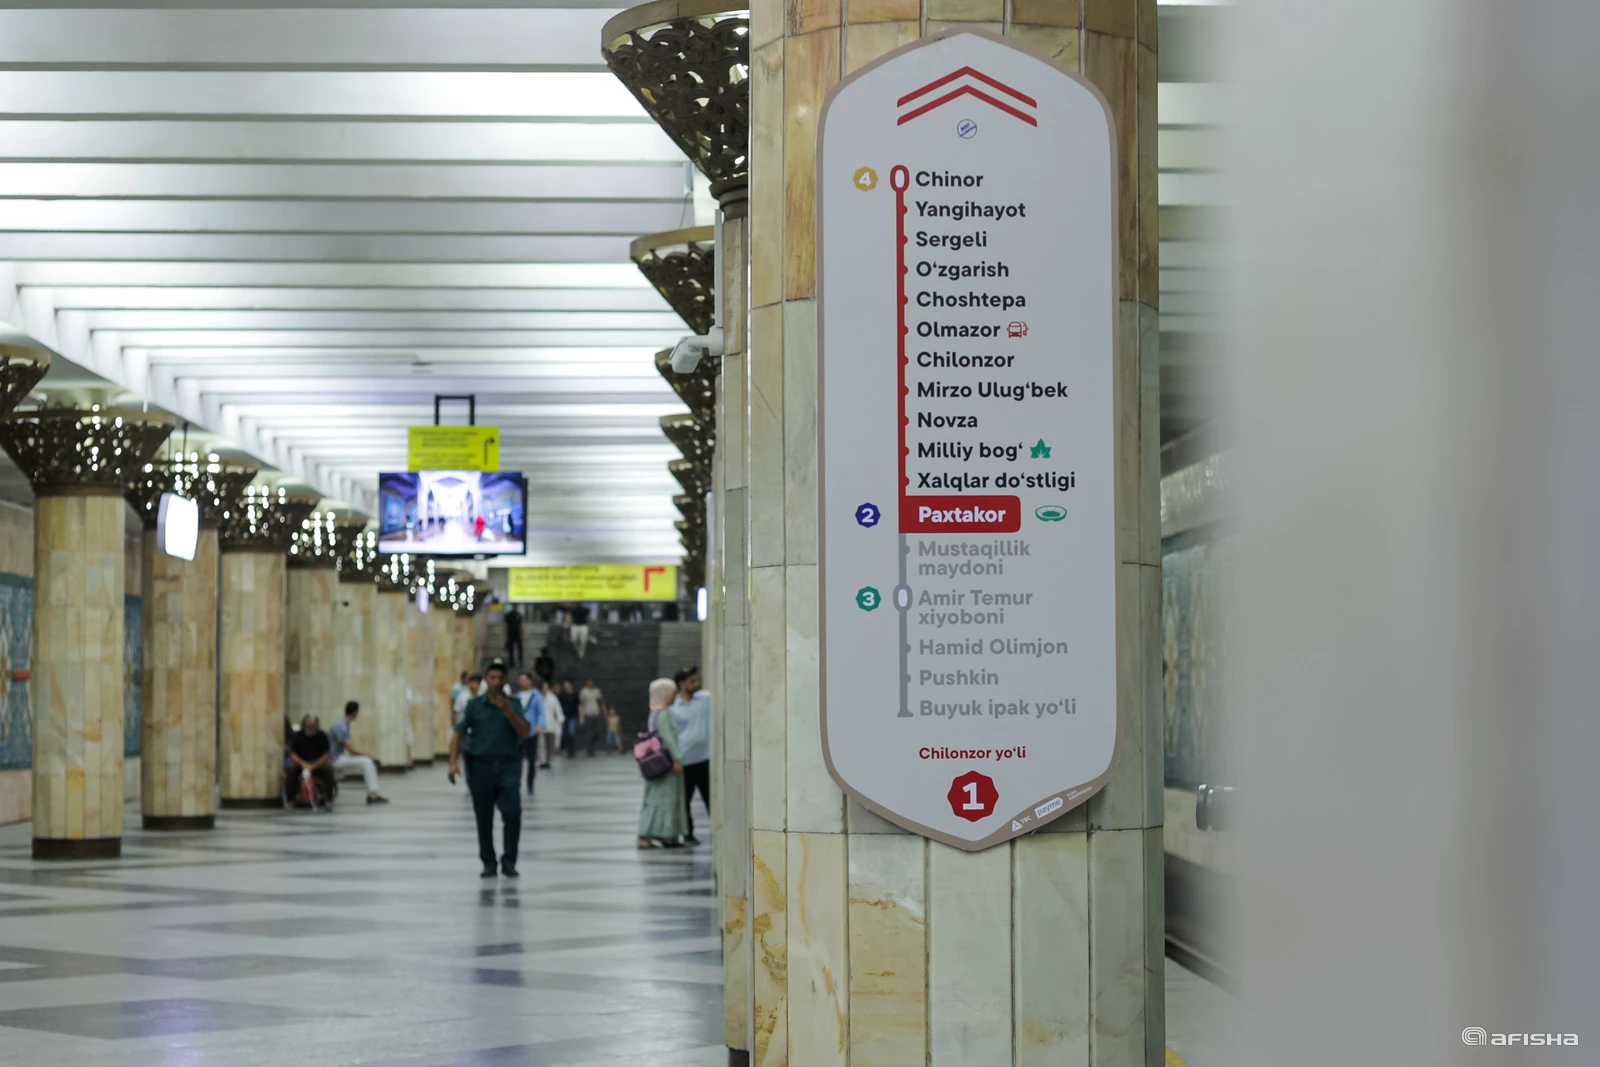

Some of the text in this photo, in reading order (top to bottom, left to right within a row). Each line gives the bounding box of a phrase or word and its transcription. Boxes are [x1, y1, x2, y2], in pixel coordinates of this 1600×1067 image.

[859, 172, 872, 186] 4
[915, 171, 984, 188] Chinor
[915, 201, 1026, 221] Yangihayot
[915, 231, 988, 251] Sergeli
[915, 261, 1010, 281] O‘zgarish
[916, 291, 1026, 311] Choshtepa
[916, 321, 1001, 338] Olmazor
[916, 351, 1015, 368] Chilonzor
[917, 381, 1069, 402] Mirzo Ulug‘bek
[917, 411, 978, 429] Novza
[917, 441, 974, 462] Milliy
[917, 471, 990, 493] Xalqlar
[861, 508, 875, 523] 2
[918, 506, 1007, 523] Paxtakor
[918, 540, 1031, 560] Mustaqillik
[918, 559, 1004, 577] maydoni
[862, 591, 876, 607] 3
[918, 590, 1034, 606] Amir Temur
[918, 609, 1005, 628] xiyoboni
[919, 638, 1068, 658] Hamid Olimjon
[919, 669, 999, 686] Pushkin
[919, 699, 983, 719] Buyuk
[987, 698, 1030, 719] ipak
[918, 746, 992, 760] Chilonzor
[961, 781, 985, 812] 1
[1036, 799, 1061, 817] payme
